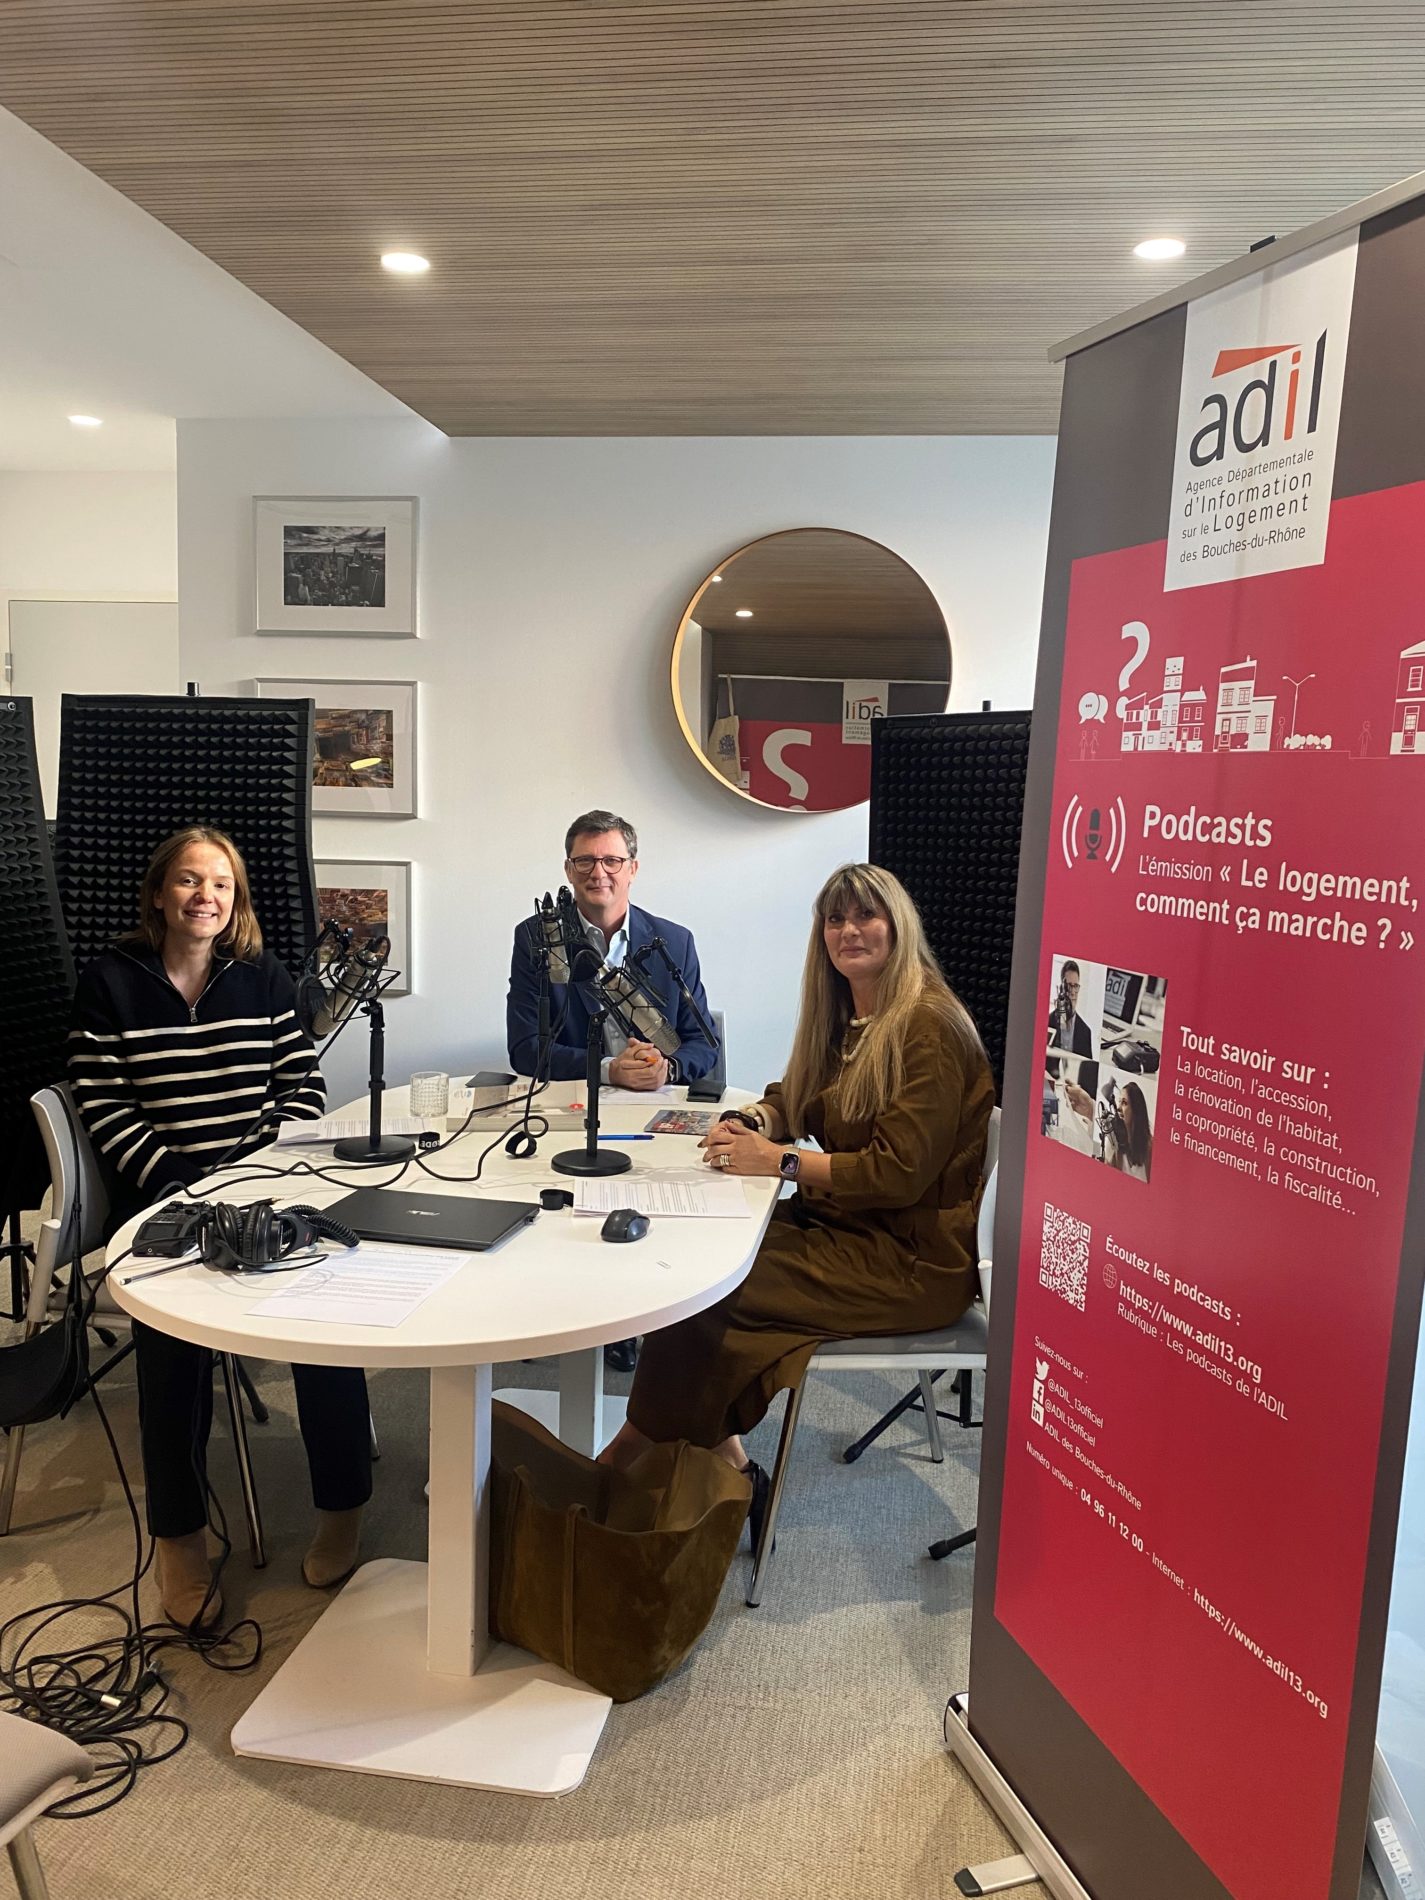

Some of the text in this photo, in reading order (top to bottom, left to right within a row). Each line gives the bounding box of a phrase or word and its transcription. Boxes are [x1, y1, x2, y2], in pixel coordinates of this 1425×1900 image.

[1189, 328, 1327, 467] adil
[1184, 472, 1312, 518] d'Information
[1185, 449, 1314, 495] Agence Départementale
[1180, 525, 1306, 563] des Bouches-du-Rhône
[1181, 493, 1309, 539] sur le Logement
[1142, 804, 1273, 847] Podcasts
[1138, 854, 1212, 882] L'émission
[1240, 858, 1268, 889] Le
[1278, 861, 1418, 912] logement,
[1135, 892, 1230, 925] comment
[1235, 906, 1261, 934] ça
[1267, 911, 1368, 946] marche
[1180, 1025, 1215, 1056] Tout
[1220, 1043, 1276, 1073] savoir
[1281, 1060, 1316, 1084] sur
[1174, 1079, 1343, 1154] la rénovation de l'habitat,
[1177, 1055, 1332, 1122] La location, l'accession,
[1170, 1127, 1180, 1145] le
[1184, 1132, 1261, 1182] financement,
[1267, 1165, 1279, 1185] la
[1172, 1103, 1380, 1198] la copropriété, la construction,
[1105, 1234, 1150, 1275] Écoutez
[1153, 1262, 1171, 1286] les
[1174, 1278, 1232, 1321] podcasts
[1034, 1335, 1072, 1371] Suivez-nous
[1072, 1366, 1084, 1380] sur
[1119, 1280, 1262, 1384] https://www.adil13.org
[1117, 1302, 1158, 1338] Rubrique
[1166, 1332, 1184, 1355] Les
[1186, 1348, 1233, 1386] podcasts
[1235, 1378, 1250, 1397] de
[1253, 1387, 1289, 1421] l'ADIL
[1044, 1398, 1096, 1447] @ADIL13officiel
[1047, 1378, 1104, 1429] @ADIL_13officiel
[1044, 1422, 1142, 1511] ADIL des Bouches-du-Rhône
[1026, 1440, 1050, 1470] Numéro
[1051, 1465, 1074, 1491] unique
[1080, 1488, 1091, 1506] 04
[1093, 1499, 1105, 1518] 96
[1107, 1512, 1116, 1528] 11
[1119, 1522, 1129, 1540] 12
[1131, 1533, 1144, 1552] 00
[1152, 1552, 1185, 1591] Internet
[1193, 1587, 1328, 1719] https://www.adil13.org
